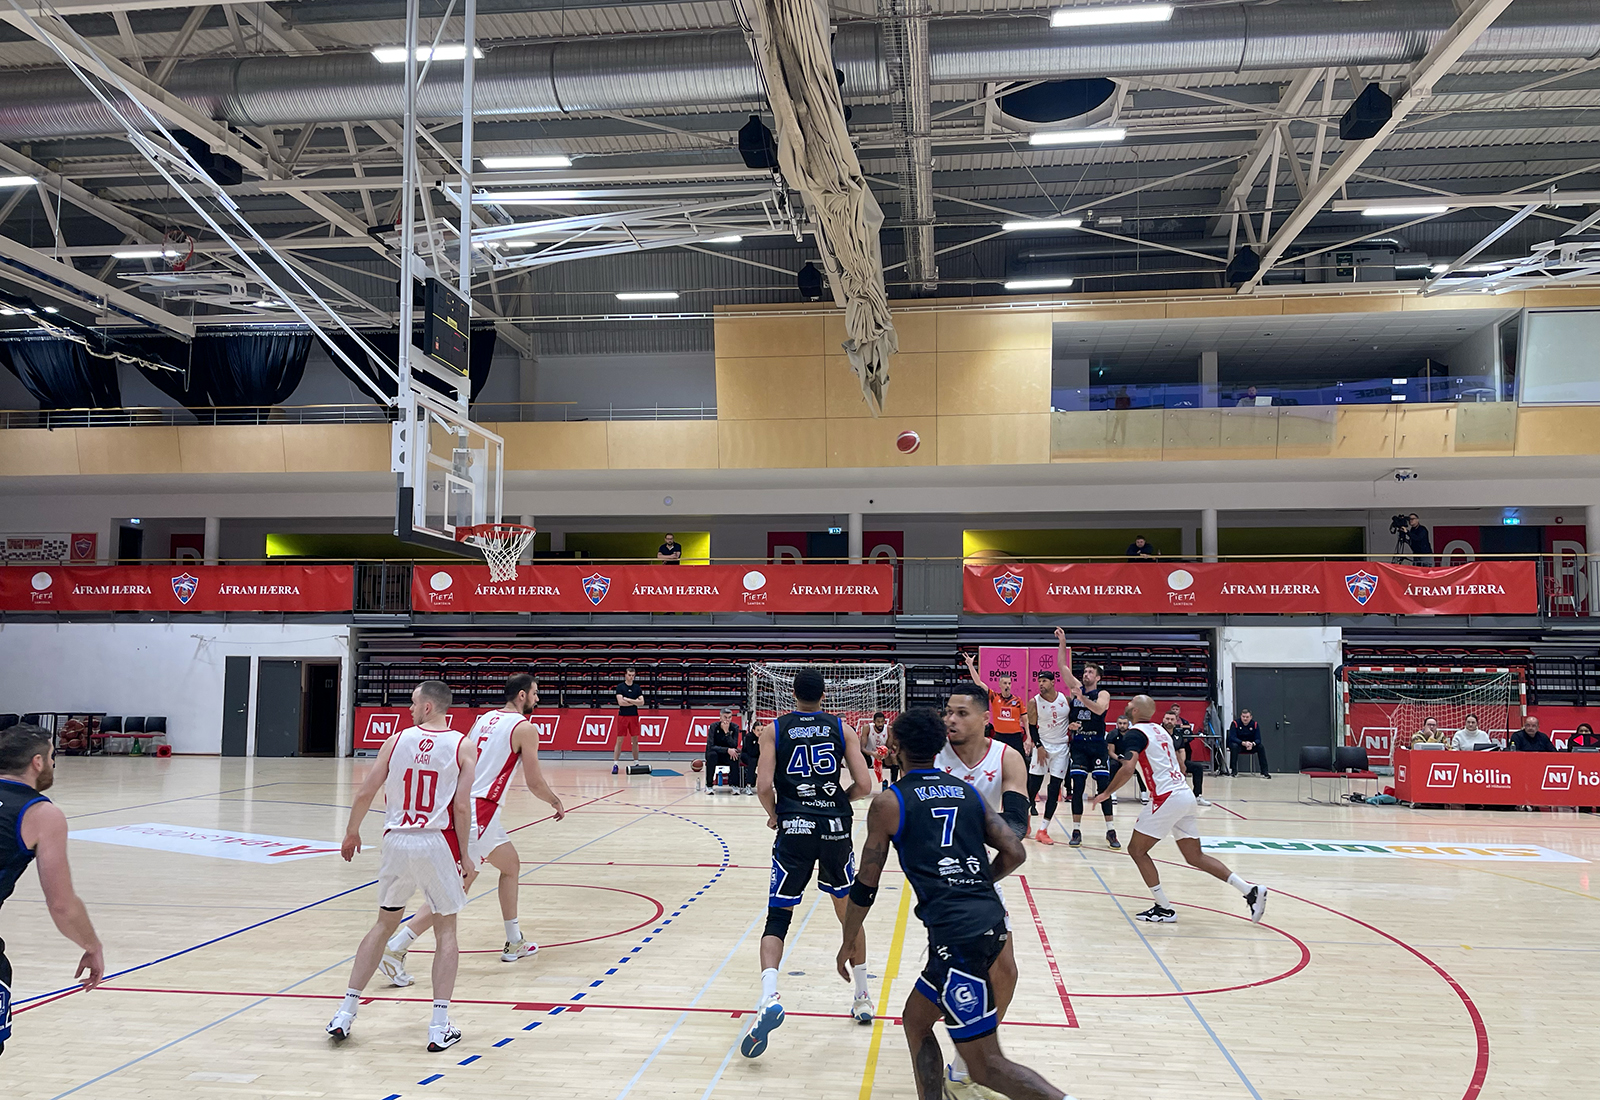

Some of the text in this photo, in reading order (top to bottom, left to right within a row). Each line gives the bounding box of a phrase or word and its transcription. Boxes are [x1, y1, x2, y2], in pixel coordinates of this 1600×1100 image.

[72, 583, 152, 594] ÁFRAM HÆRRA
[218, 583, 300, 594] ÁFRAM HÆRRA
[474, 584, 561, 596] ÁFRAM HÆRRA
[632, 584, 720, 596] ÁFRAM HÆRRA
[789, 584, 879, 596] ÁFRAM HÆRRA
[1046, 582, 1142, 595] ÁFRAM HÆRRA
[1220, 582, 1320, 595] ÁFRAM HÆRRA
[1404, 583, 1506, 596] ÁFRAM HÆRRA
[372, 722, 392, 734] N1
[586, 724, 605, 736] N1
[640, 724, 660, 737] N1
[694, 724, 710, 737] N
[788, 726, 832, 740] SEMPLE
[1366, 736, 1388, 750] N1
[414, 754, 431, 765] KARI
[786, 742, 837, 778] 45
[1434, 768, 1511, 784] N1 höllin
[1548, 772, 1566, 783] N1
[402, 768, 438, 813] 10
[914, 785, 966, 802] KANE
[930, 806, 958, 848] 7
[1201, 840, 1542, 858] SUBWAY
